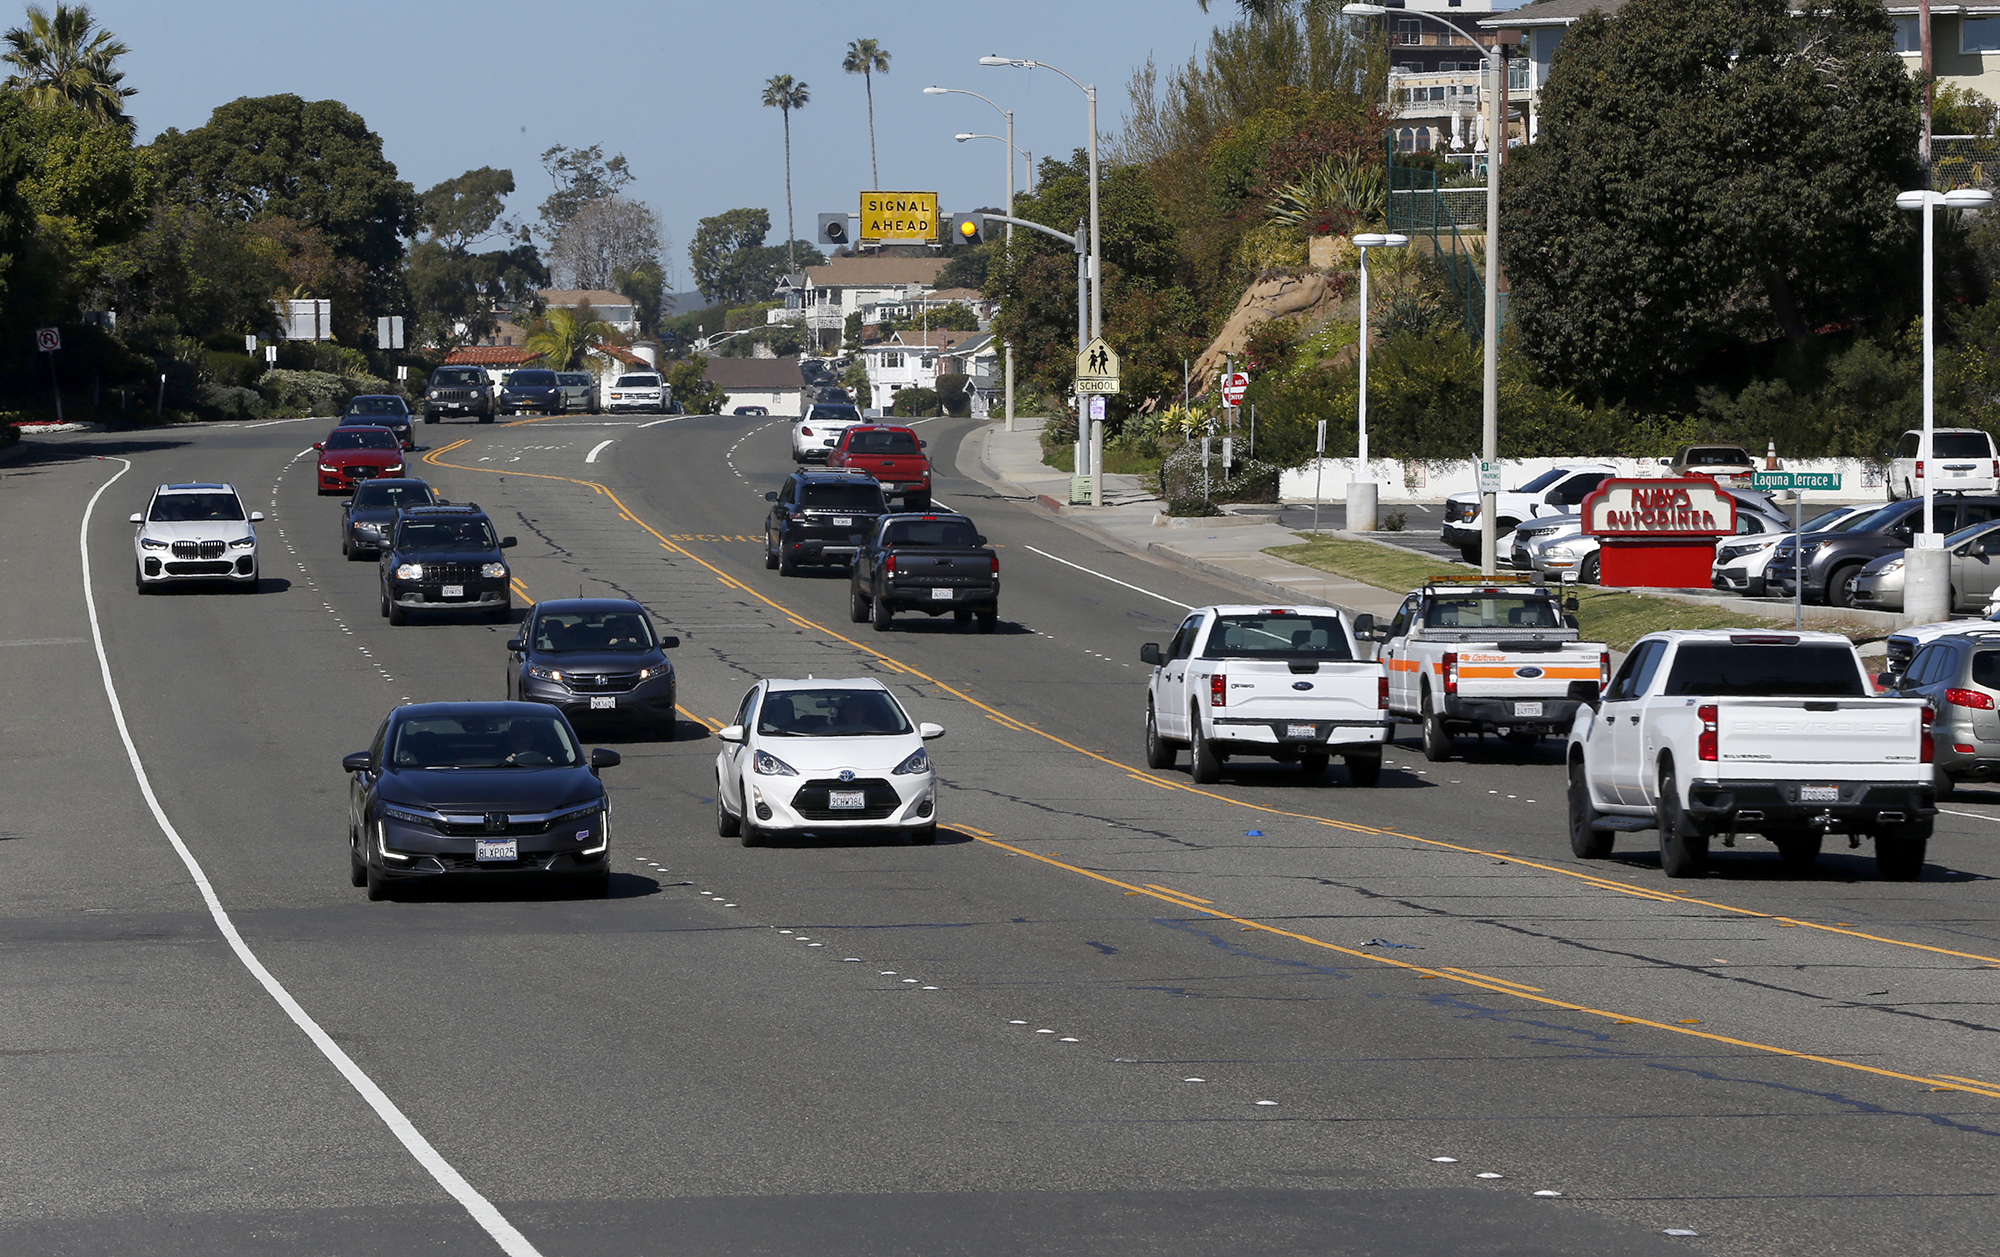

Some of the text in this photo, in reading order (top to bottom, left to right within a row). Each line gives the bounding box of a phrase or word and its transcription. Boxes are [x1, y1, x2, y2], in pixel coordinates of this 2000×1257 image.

[868, 200, 930, 213] SIGNAL
[870, 219, 928, 232] AHEAD
[1079, 381, 1116, 391] SCHOOL
[1482, 463, 1488, 471] 3
[1754, 473, 1839, 489] Laguna Terrace N
[1607, 510, 1714, 526] AUTODINER
[1472, 654, 1506, 662] Caltrans
[1733, 721, 1907, 734] CHEVROLET
[831, 797, 863, 807] 9CHW384
[478, 846, 516, 858] 8LXP025
